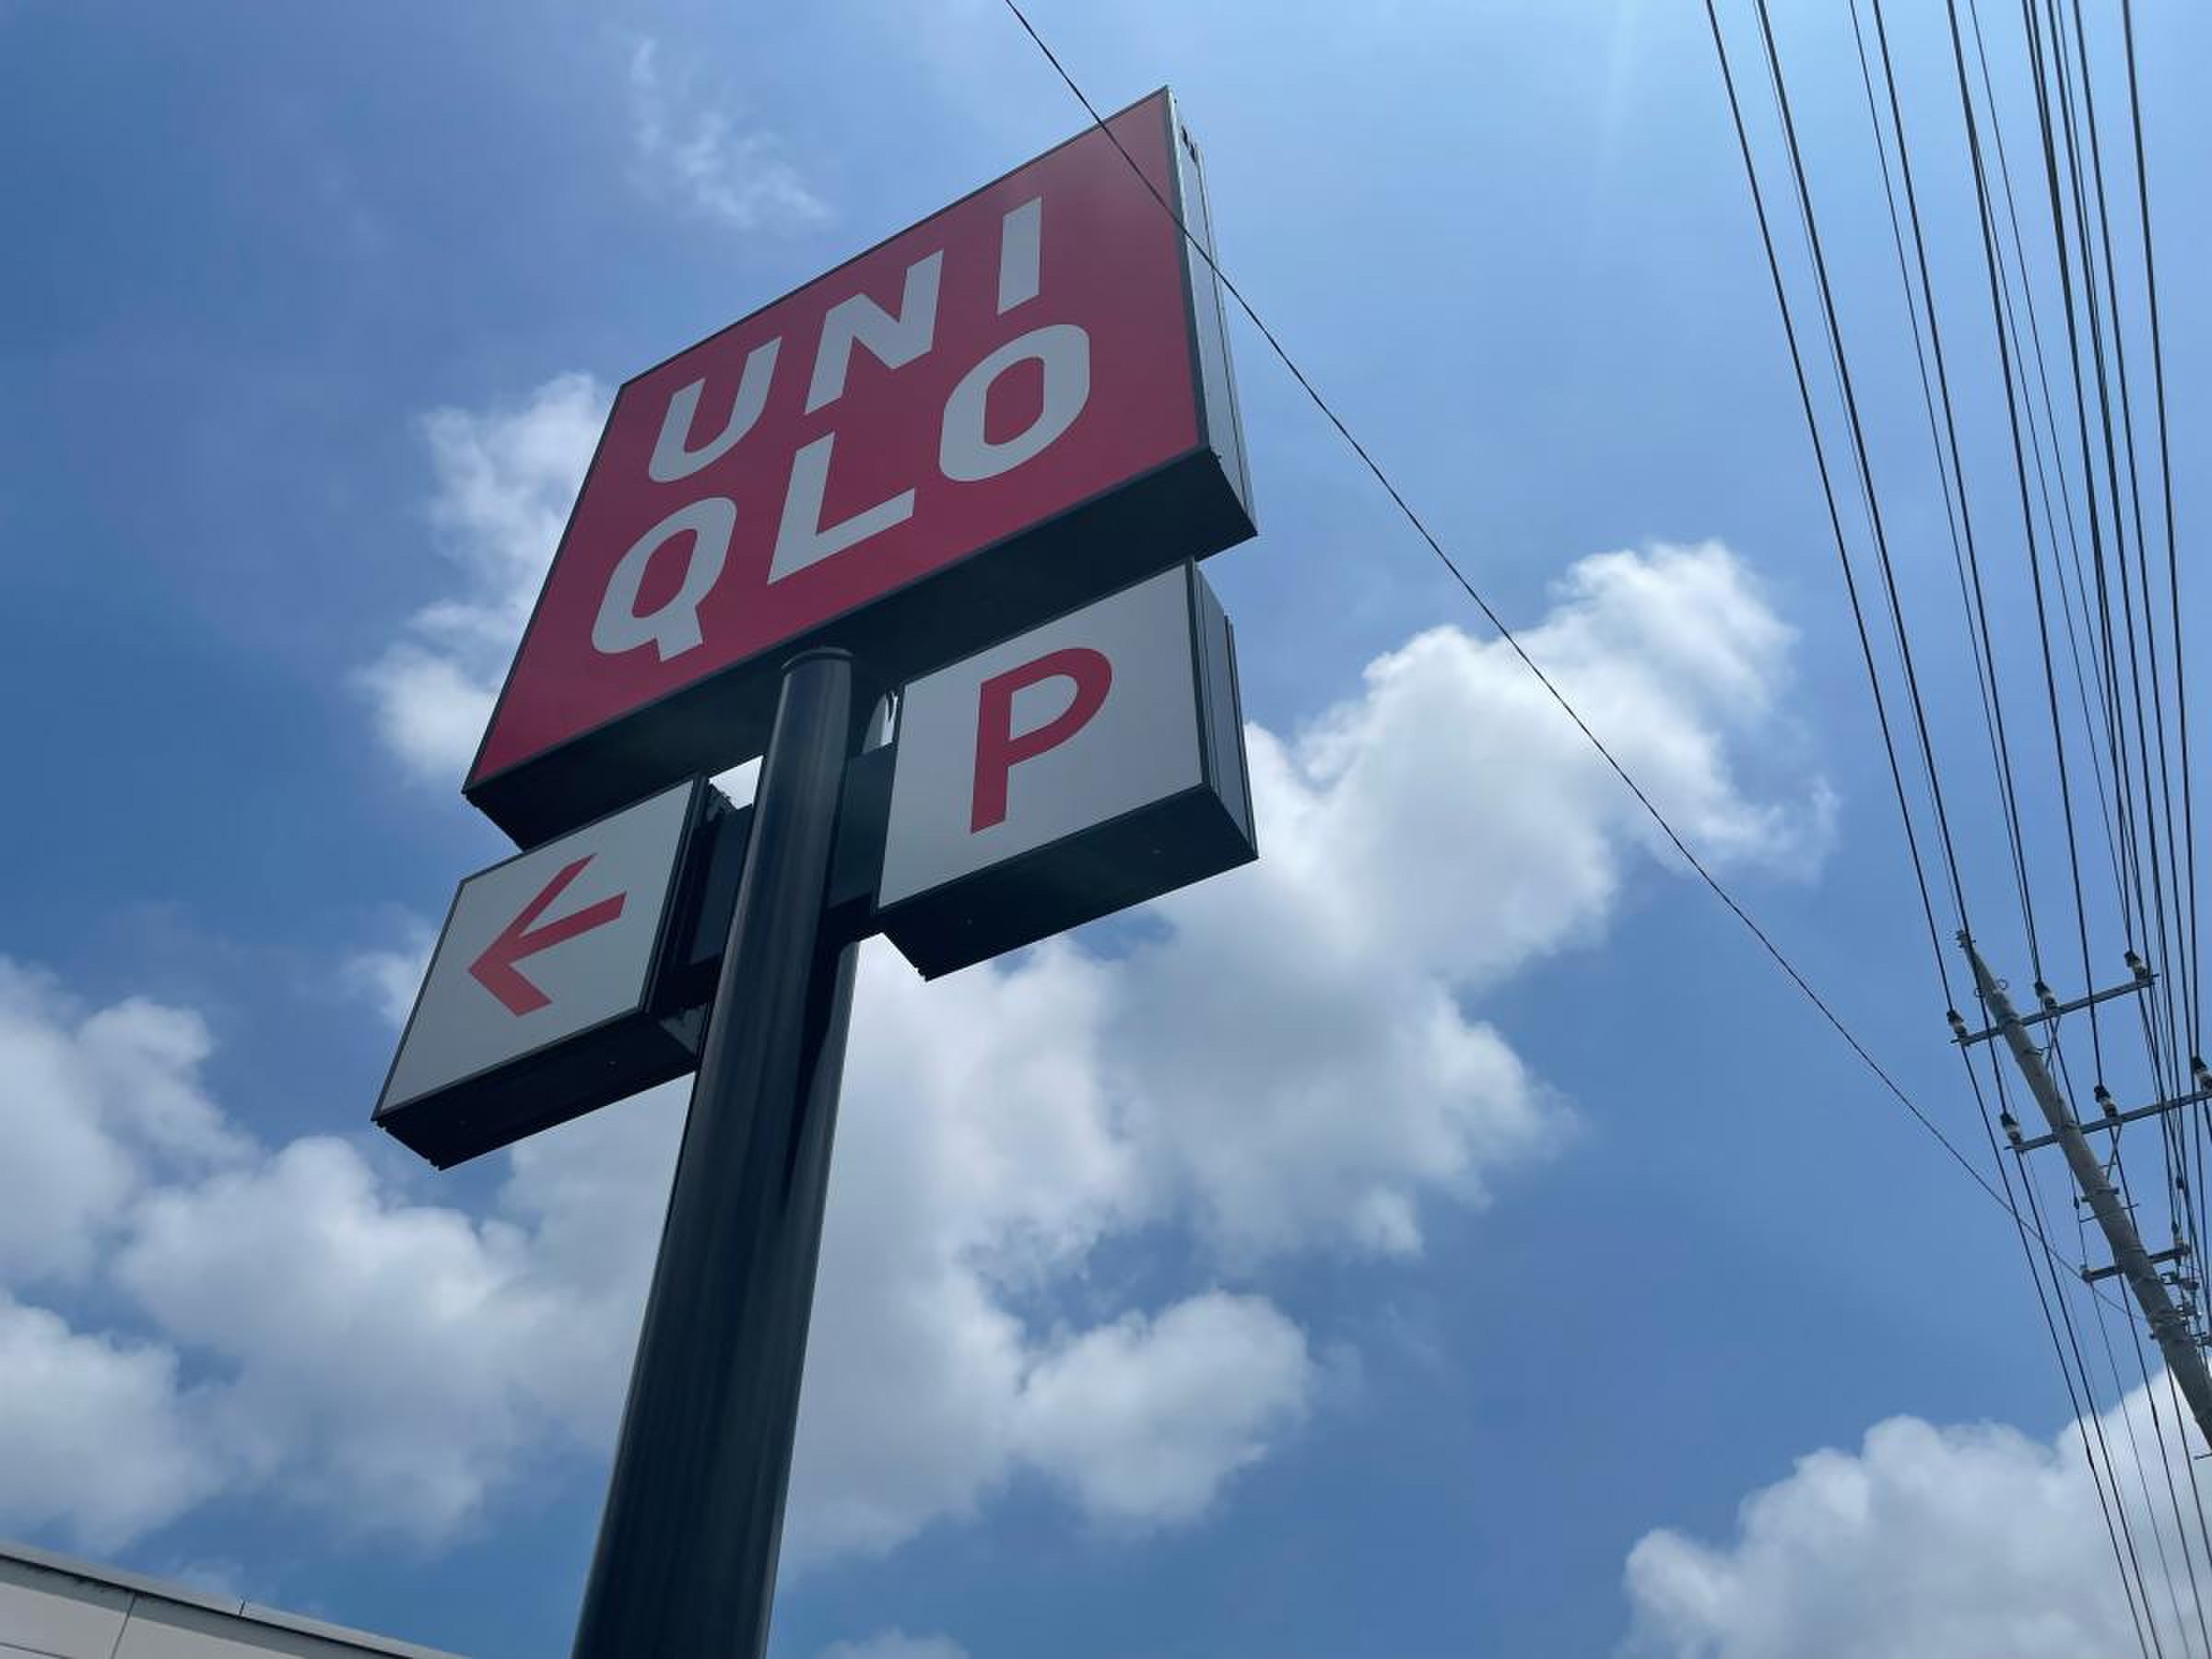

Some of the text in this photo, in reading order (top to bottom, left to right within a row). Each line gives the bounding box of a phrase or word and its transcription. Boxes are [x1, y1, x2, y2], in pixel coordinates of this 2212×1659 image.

[648, 195, 1042, 484] UNI
[591, 324, 1090, 664] QLO
[971, 647, 1112, 833] P
